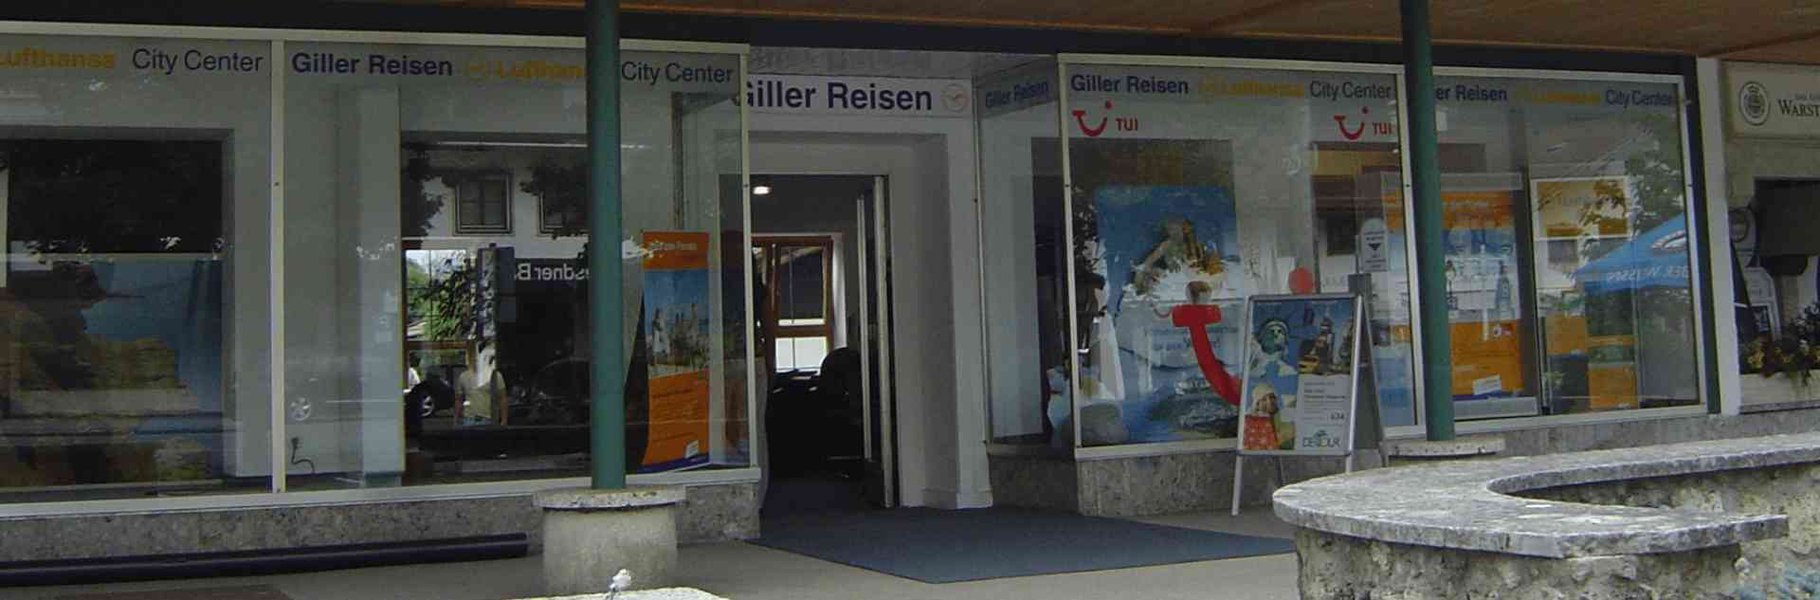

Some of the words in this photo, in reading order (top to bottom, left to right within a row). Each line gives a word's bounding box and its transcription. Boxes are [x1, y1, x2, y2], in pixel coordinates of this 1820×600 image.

[132, 48, 178, 75] City
[184, 49, 263, 72] Center
[292, 52, 360, 74] Giller
[369, 54, 453, 77] Reisen
[621, 61, 660, 86] City
[665, 62, 735, 83] Center
[827, 81, 932, 111] Reisen
[1071, 74, 1121, 92] Giller
[1126, 76, 1189, 94] Reisen
[1310, 80, 1339, 101] City
[1343, 81, 1392, 99] Center
[1456, 84, 1508, 101] Reisen
[1605, 89, 1631, 109] City
[1632, 90, 1672, 106] Center
[1115, 117, 1139, 132] TUI
[1372, 122, 1393, 136] TUI
